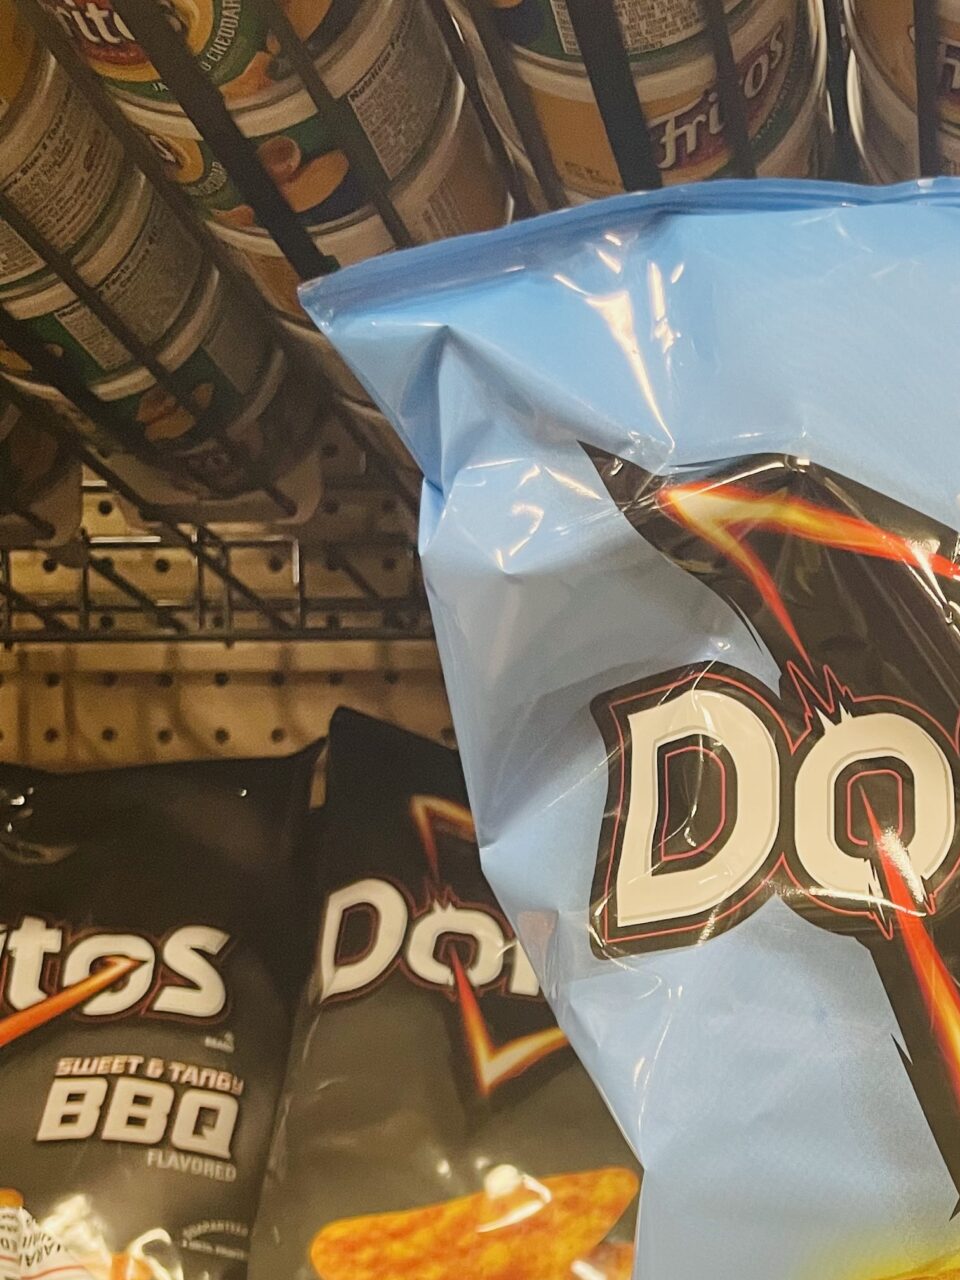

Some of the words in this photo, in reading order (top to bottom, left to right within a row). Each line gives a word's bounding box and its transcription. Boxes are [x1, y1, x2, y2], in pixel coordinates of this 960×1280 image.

[650, 24, 783, 169] Frios
[57, 1055, 144, 1077] SWEET
[149, 1058, 164, 1079] &
[169, 1062, 244, 1096] TANGY
[36, 1076, 239, 1160] BBQ
[147, 1149, 237, 1183] FLAVORED
